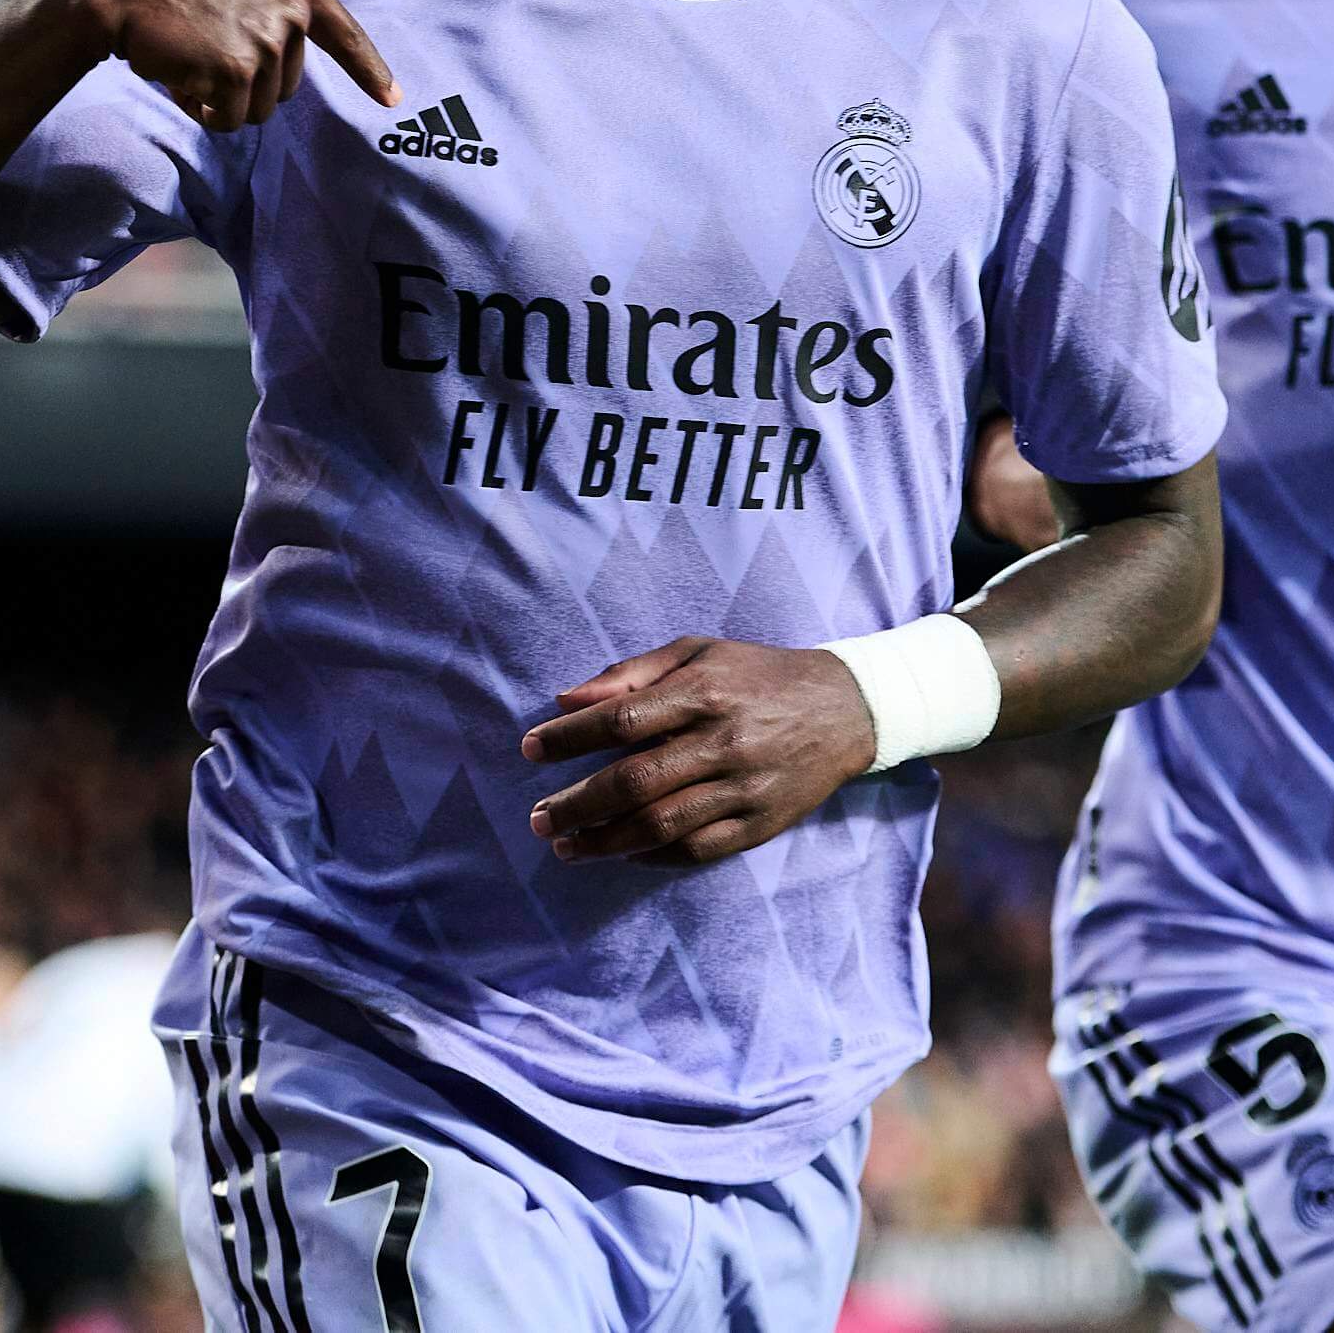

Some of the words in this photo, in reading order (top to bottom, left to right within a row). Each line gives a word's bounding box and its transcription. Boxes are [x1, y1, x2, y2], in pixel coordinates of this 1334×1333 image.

[378, 130, 499, 167] adidas
[371, 262, 895, 408] Emirates
[442, 400, 560, 492] FLY
[578, 412, 823, 511] BETTER
[1204, 1012, 1328, 1129] 5
[324, 1146, 431, 1333] 7
